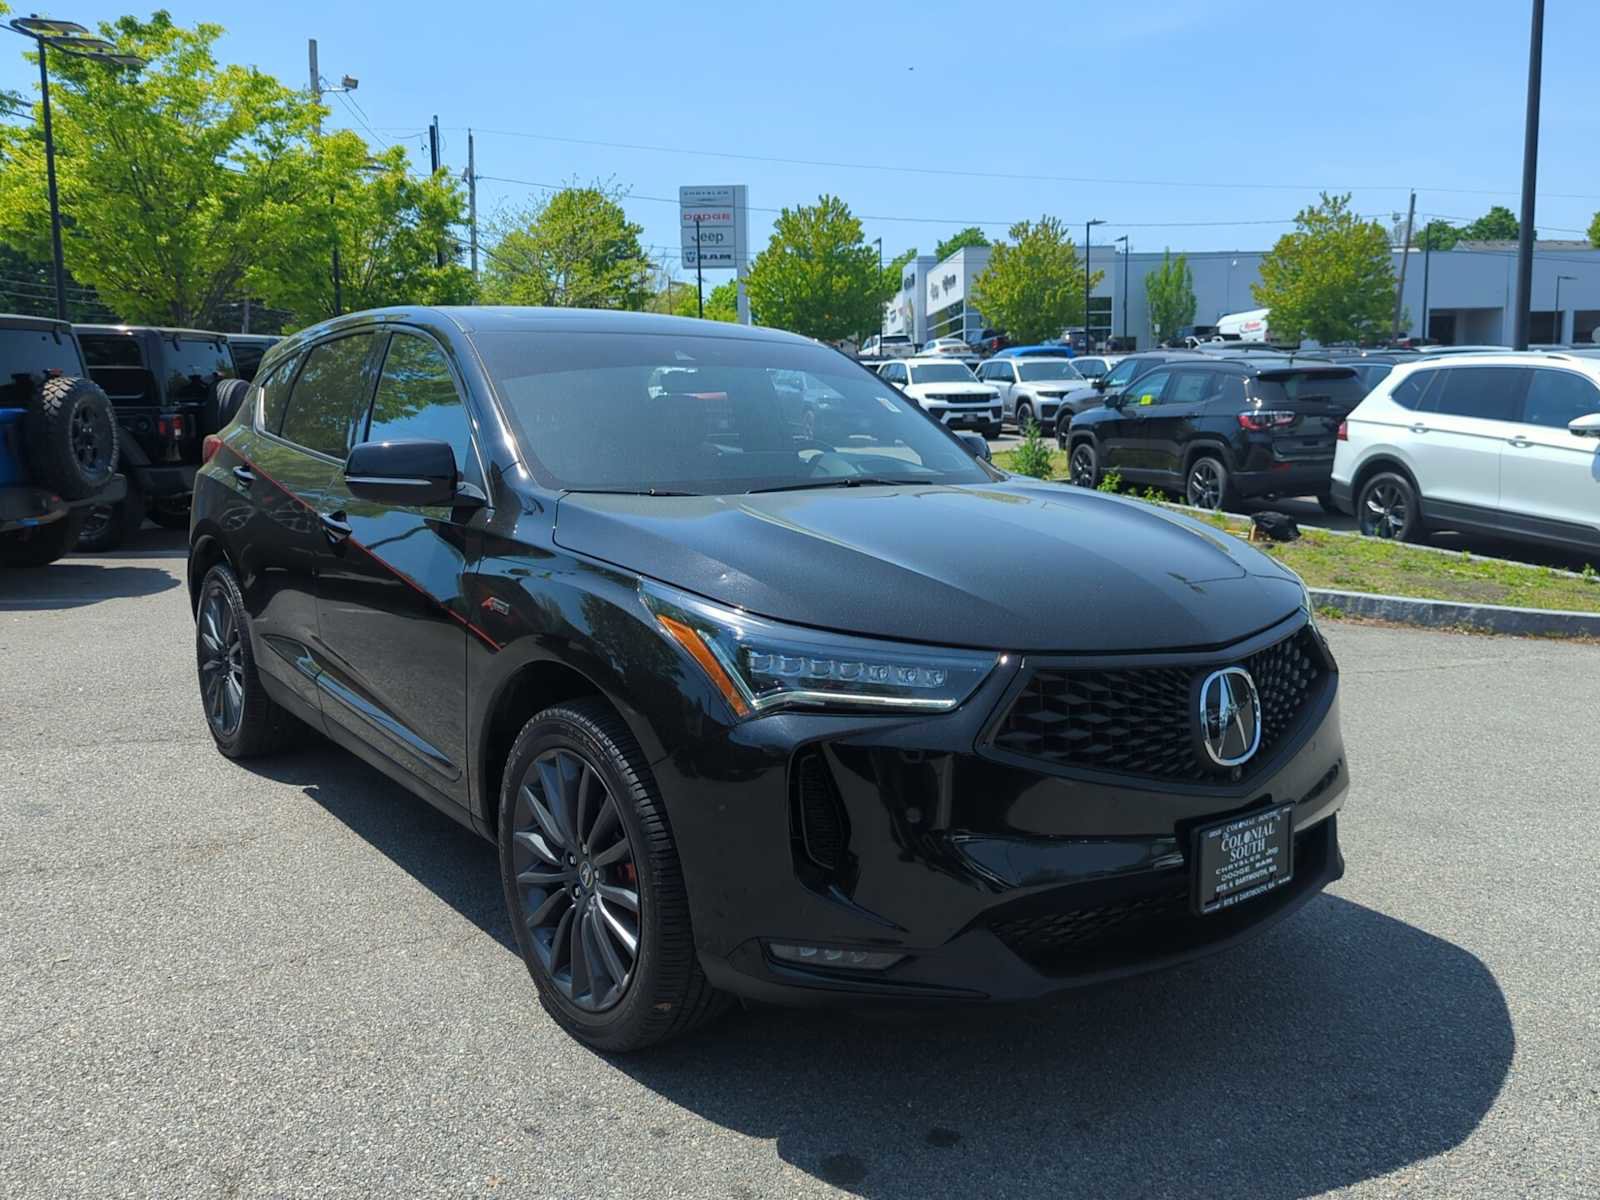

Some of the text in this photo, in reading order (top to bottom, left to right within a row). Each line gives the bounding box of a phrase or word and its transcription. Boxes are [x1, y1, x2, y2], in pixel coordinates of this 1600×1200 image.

[1221, 822, 1275, 851] COLONIAL
[1229, 838, 1265, 862] SOUTH
[1215, 854, 1261, 875] CHRYSLER
[1221, 866, 1250, 881] DODGE
